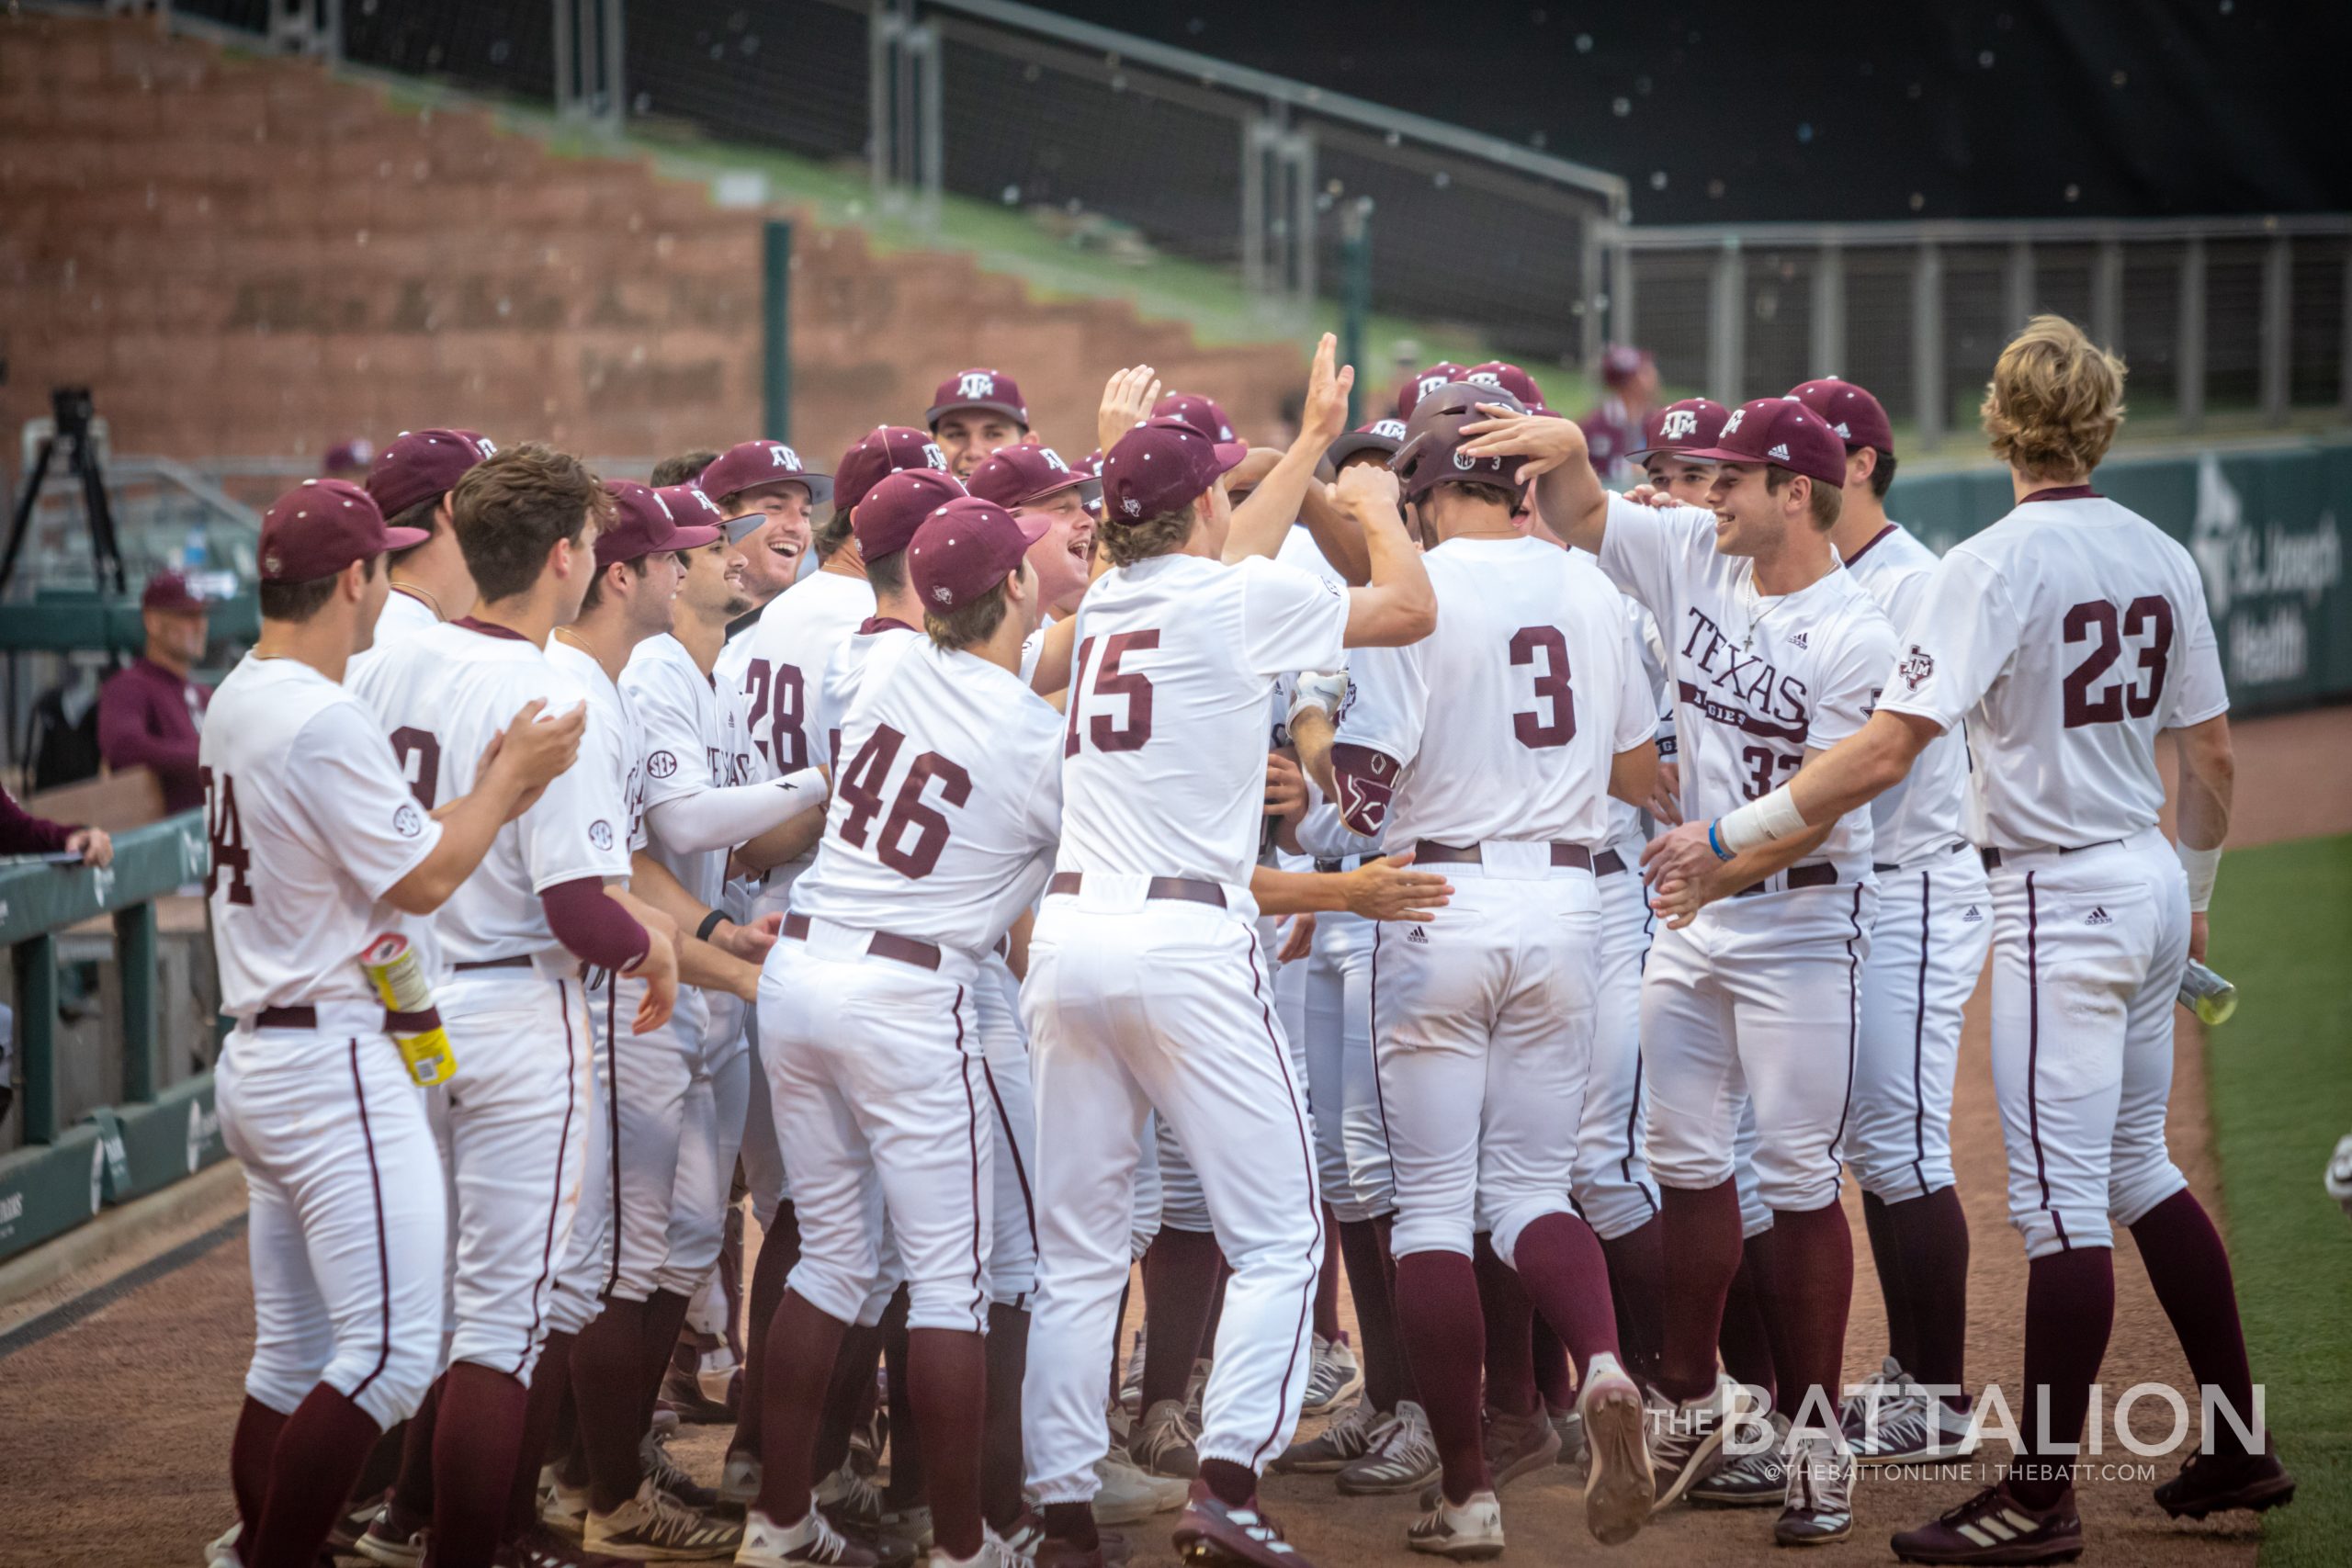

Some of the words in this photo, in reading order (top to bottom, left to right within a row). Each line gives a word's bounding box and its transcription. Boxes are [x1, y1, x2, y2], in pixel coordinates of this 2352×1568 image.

[745, 658, 808, 781] 28
[1065, 629, 1160, 760] 15
[1510, 625, 1577, 750] 3
[1681, 606, 1807, 723] TEXAS
[2063, 595, 2175, 728] 23
[648, 751, 677, 779] SEC
[838, 723, 973, 880] 46
